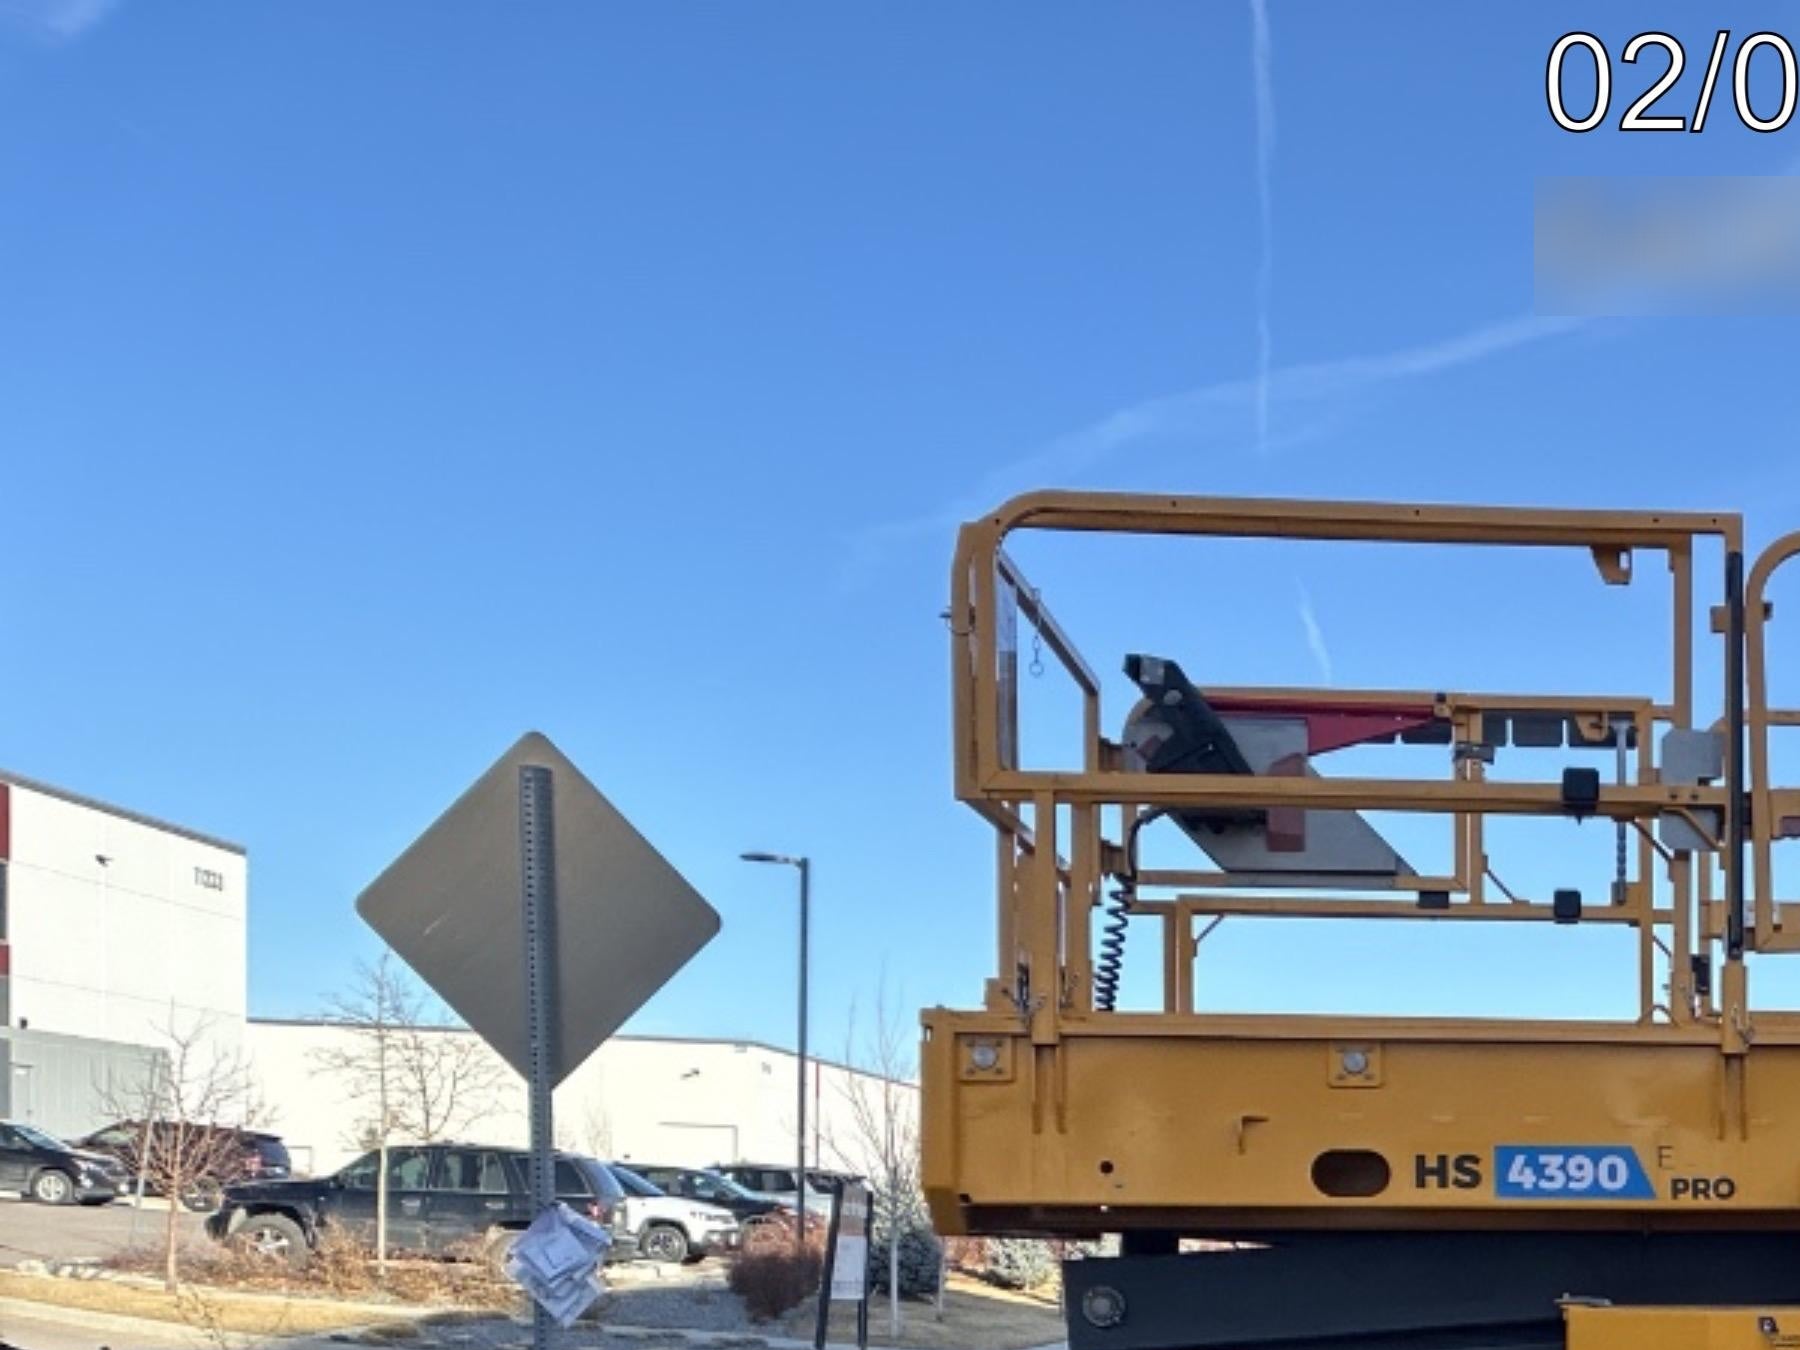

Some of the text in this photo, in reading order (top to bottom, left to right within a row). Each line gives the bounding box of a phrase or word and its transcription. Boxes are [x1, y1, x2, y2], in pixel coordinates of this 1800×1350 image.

[1415, 1154, 1482, 1189] HS
[1508, 1154, 1628, 1190] 4390
[1671, 1178, 1735, 1200] PRO
